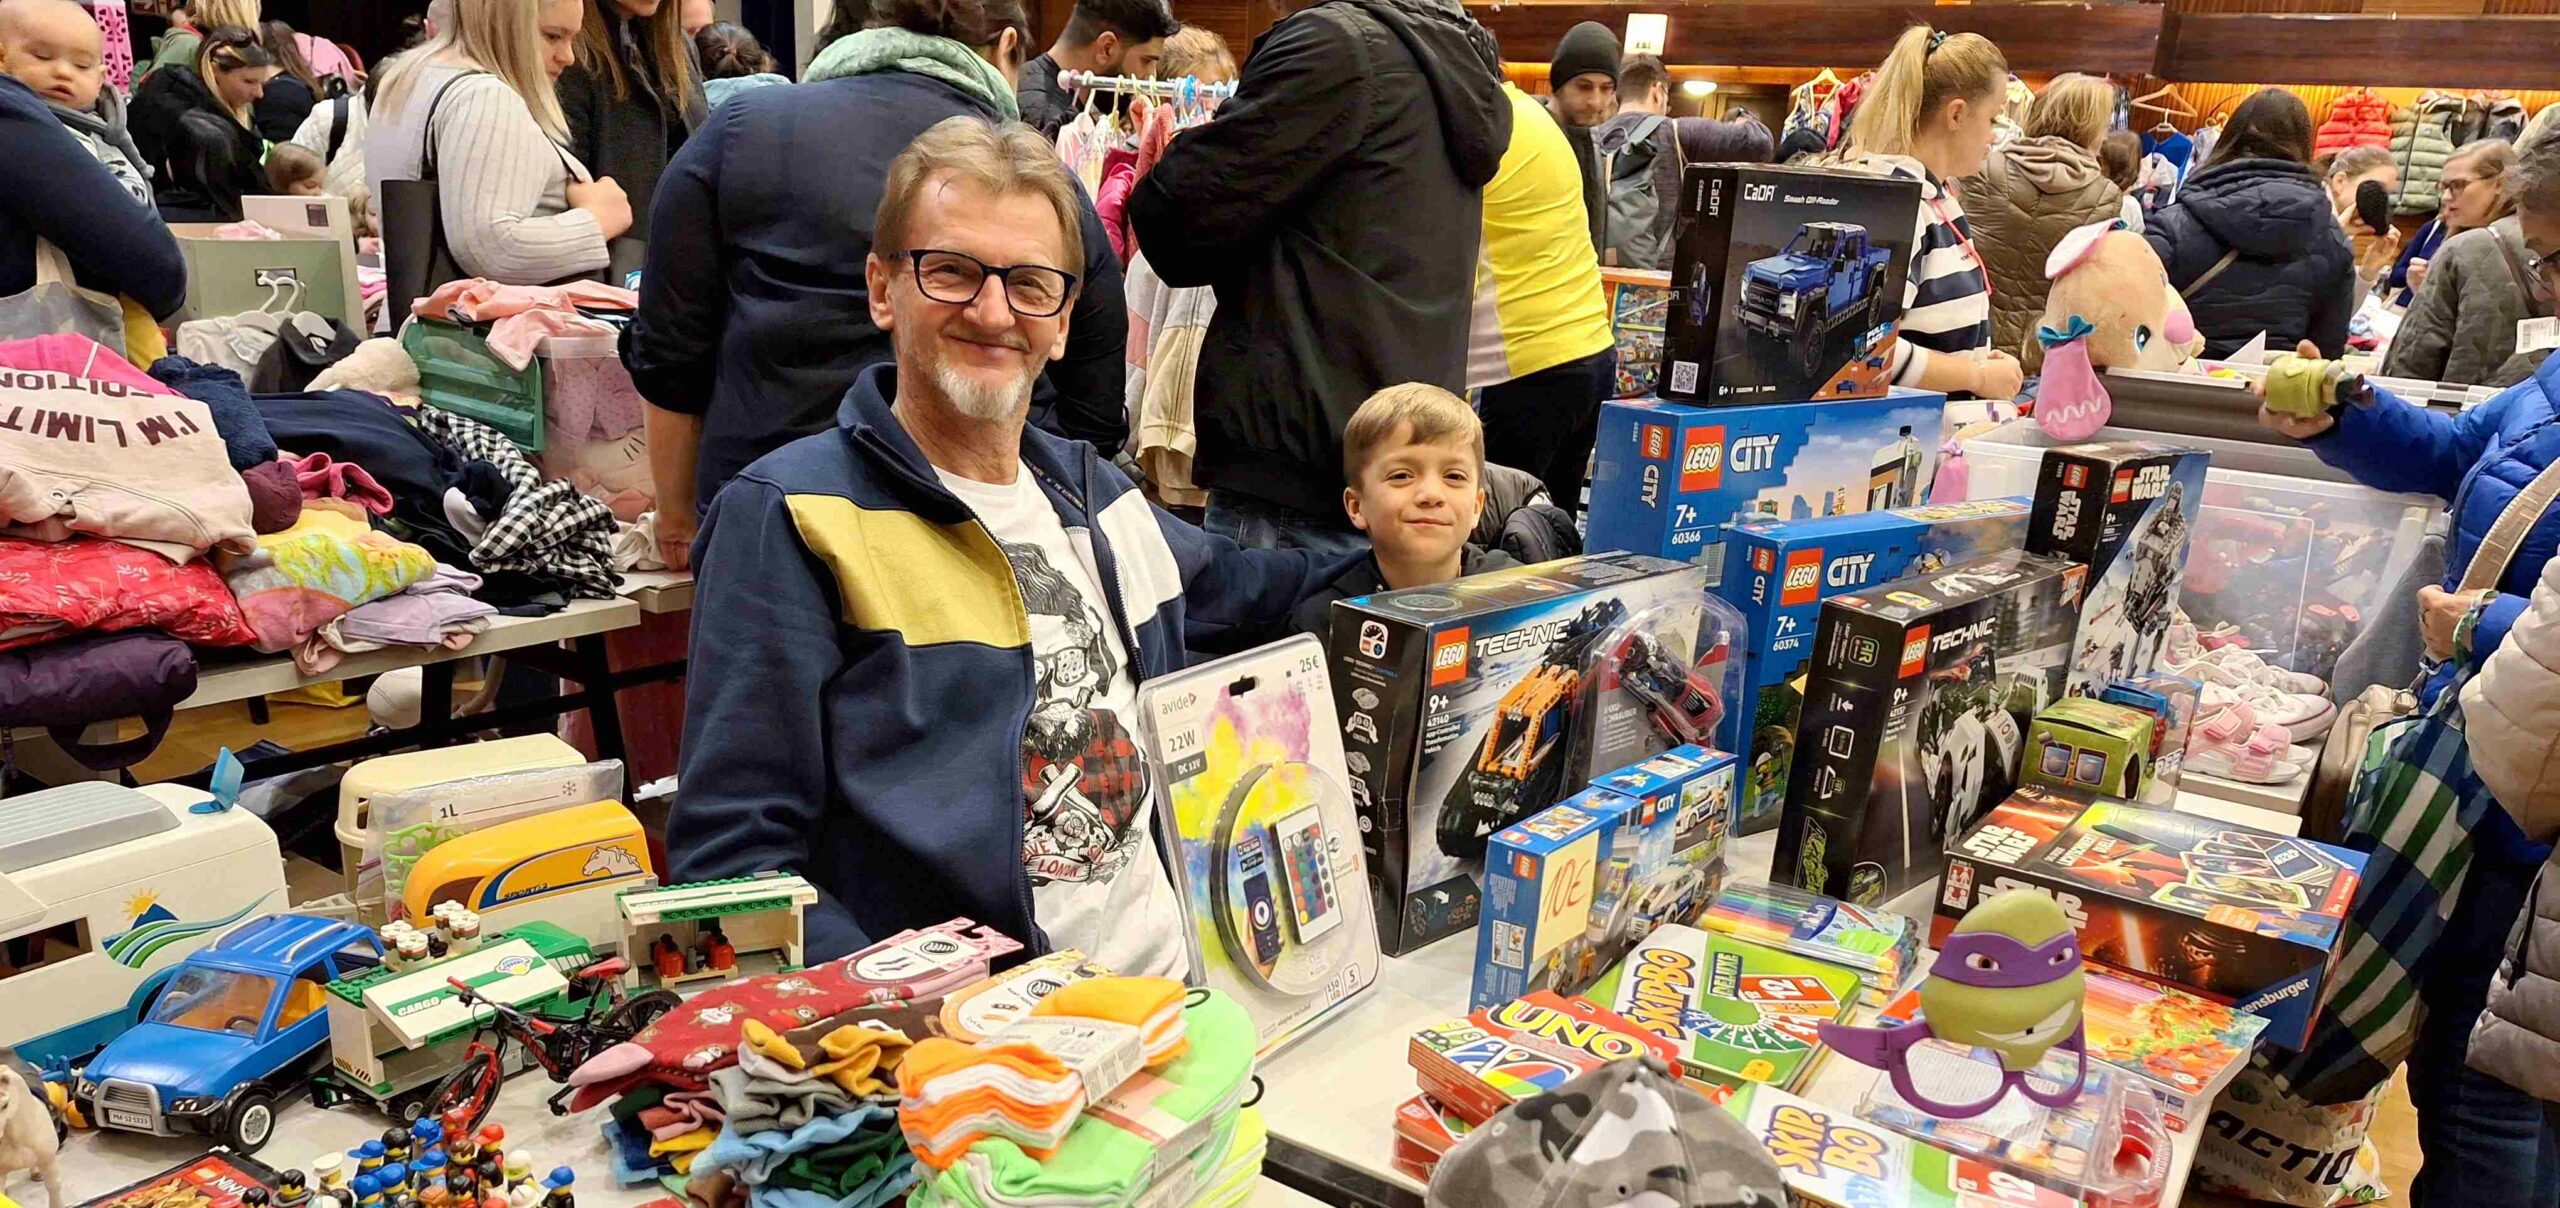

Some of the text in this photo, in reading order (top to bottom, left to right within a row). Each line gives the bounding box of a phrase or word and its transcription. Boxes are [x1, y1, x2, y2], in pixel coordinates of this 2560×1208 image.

[1744, 183, 1776, 202] CaDA
[0, 371, 155, 399] DITION
[0, 404, 128, 448] LIMIT
[1650, 425, 1663, 458] LEGO
[1729, 433, 1782, 473] CITY
[1681, 442, 1724, 474] LEGO
[1641, 464, 1660, 509] CITY
[2133, 465, 2172, 486] STAR
[2131, 480, 2169, 501] WARS
[1675, 504, 1698, 528] 7+
[1671, 530, 1701, 546] 60366
[1784, 561, 1822, 591] LEGO
[1826, 552, 1875, 588] CITY
[1752, 575, 1766, 606] CITY
[1776, 615, 1797, 637] 7+
[1932, 616, 1997, 654] TECHNIC
[1474, 620, 1571, 659] TECHNIC
[1772, 637, 1800, 651] 60374
[1902, 639, 1927, 665] LEGO
[1434, 642, 1468, 669] LEGO
[1161, 697, 1190, 716] avide
[1429, 694, 1449, 714] 9+
[1893, 687, 1908, 706] 9+
[1426, 714, 1450, 727] 42140
[1168, 729, 1196, 753] 22W
[1657, 793, 1677, 814] CITY
[1023, 839, 1051, 862] AVE
[1349, 969, 1356, 983] 5
[1711, 952, 1739, 997] DELUXE
[1758, 978, 1804, 1000] 12
[2240, 978, 2310, 1015] vensburger
[397, 996, 442, 1018] CARGO
[1492, 999, 1648, 1062] UNO
[1821, 1125, 1890, 1181] BO
[2207, 1109, 2360, 1186] ACTIO
